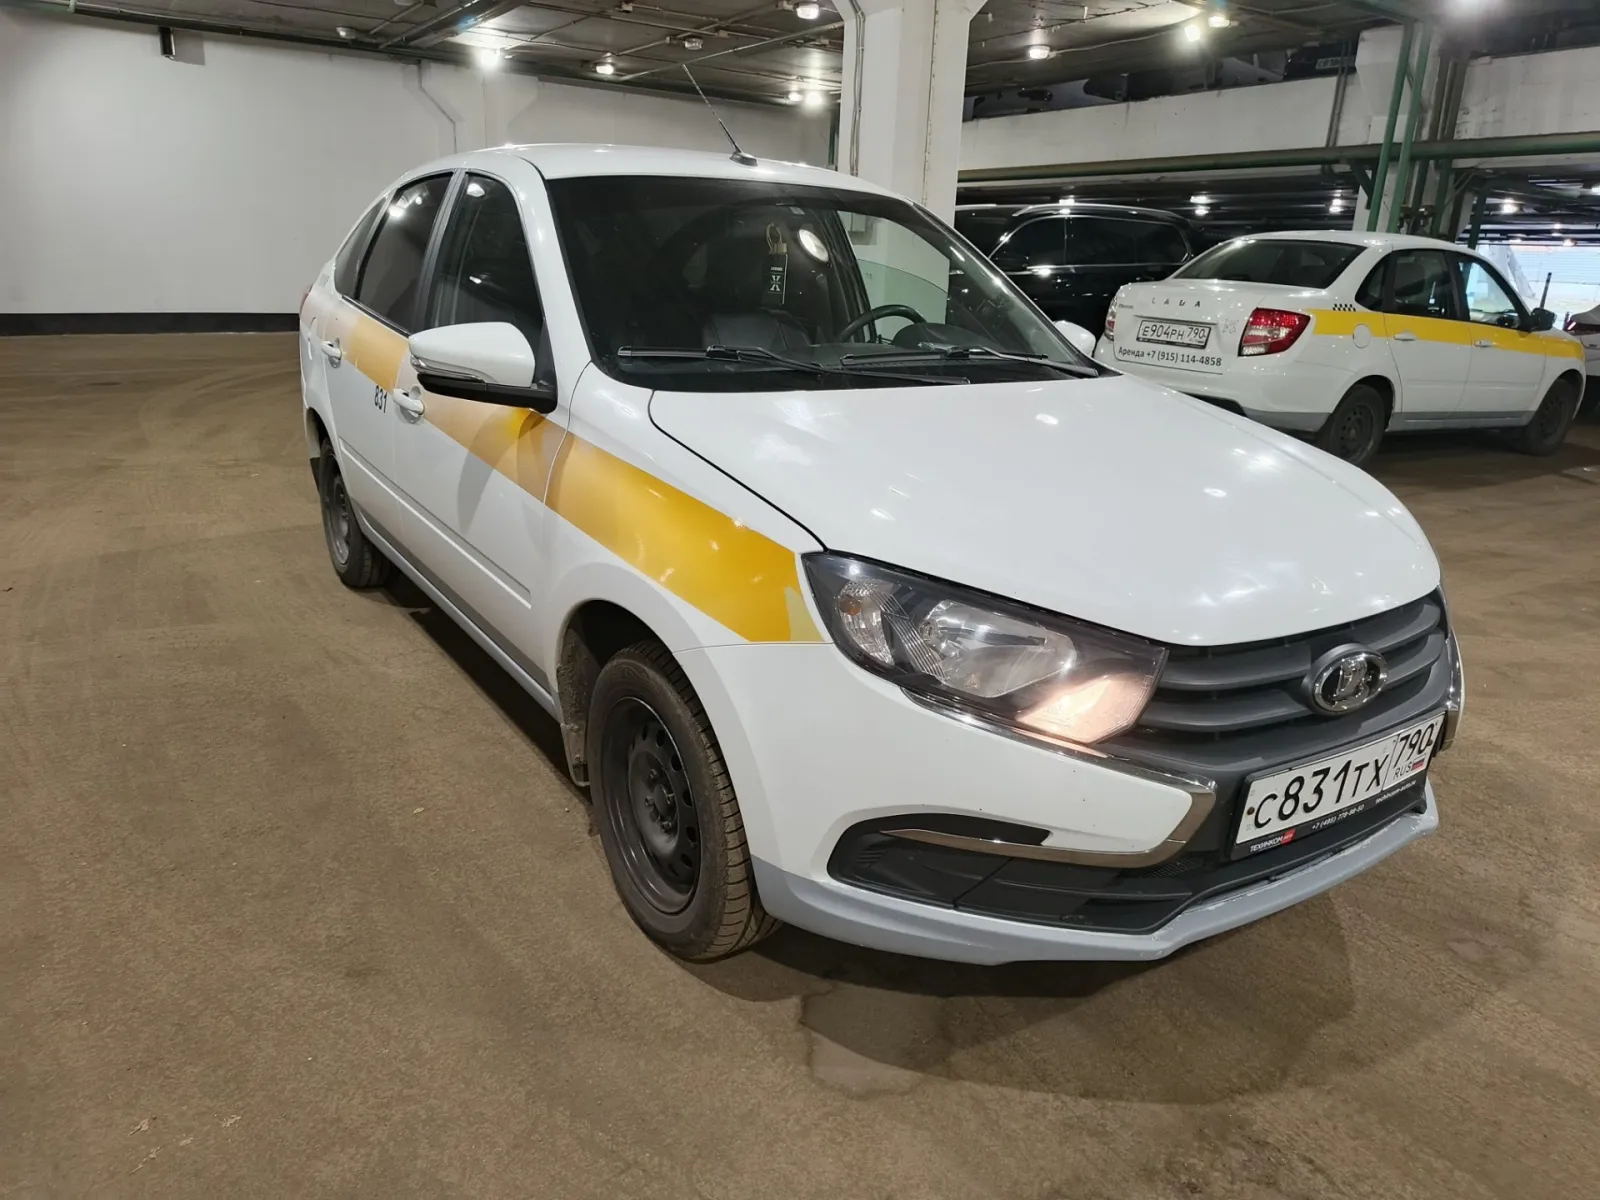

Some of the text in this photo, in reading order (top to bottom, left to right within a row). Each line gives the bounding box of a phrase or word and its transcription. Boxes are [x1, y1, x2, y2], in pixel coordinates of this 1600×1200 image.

[1118, 346, 1223, 367] Аренда +7 (915) 114-4858
[374, 384, 388, 414] 831
[1393, 722, 1435, 770] 790
[1393, 760, 1412, 781] RUS
